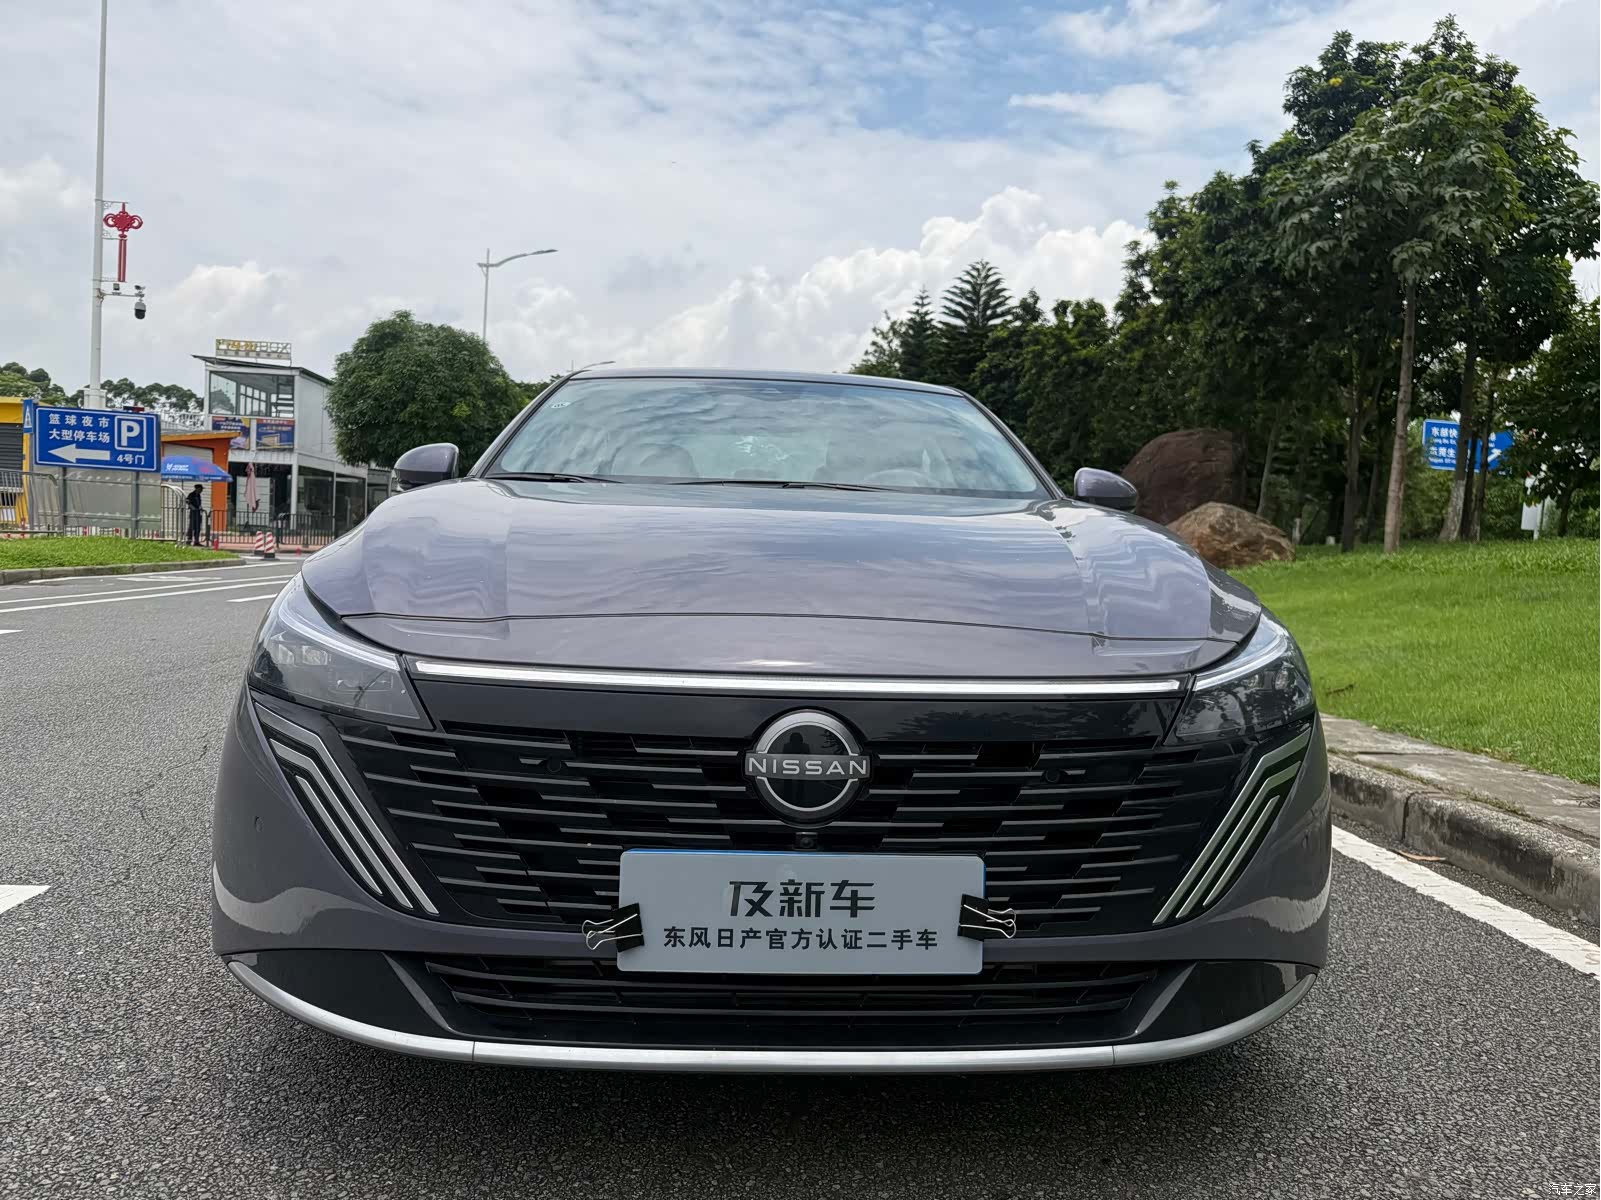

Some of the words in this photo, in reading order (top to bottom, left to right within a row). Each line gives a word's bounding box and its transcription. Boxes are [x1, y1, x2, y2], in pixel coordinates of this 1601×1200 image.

[48, 413, 111, 429] 篮球夜市
[48, 428, 111, 444] 大型停车场
[120, 420, 141, 447] P
[116, 453, 145, 466] 4号门
[748, 757, 867, 775] NISSAN
[729, 878, 876, 918] 及新车
[662, 926, 939, 951] 东风日产官方认证二手车
